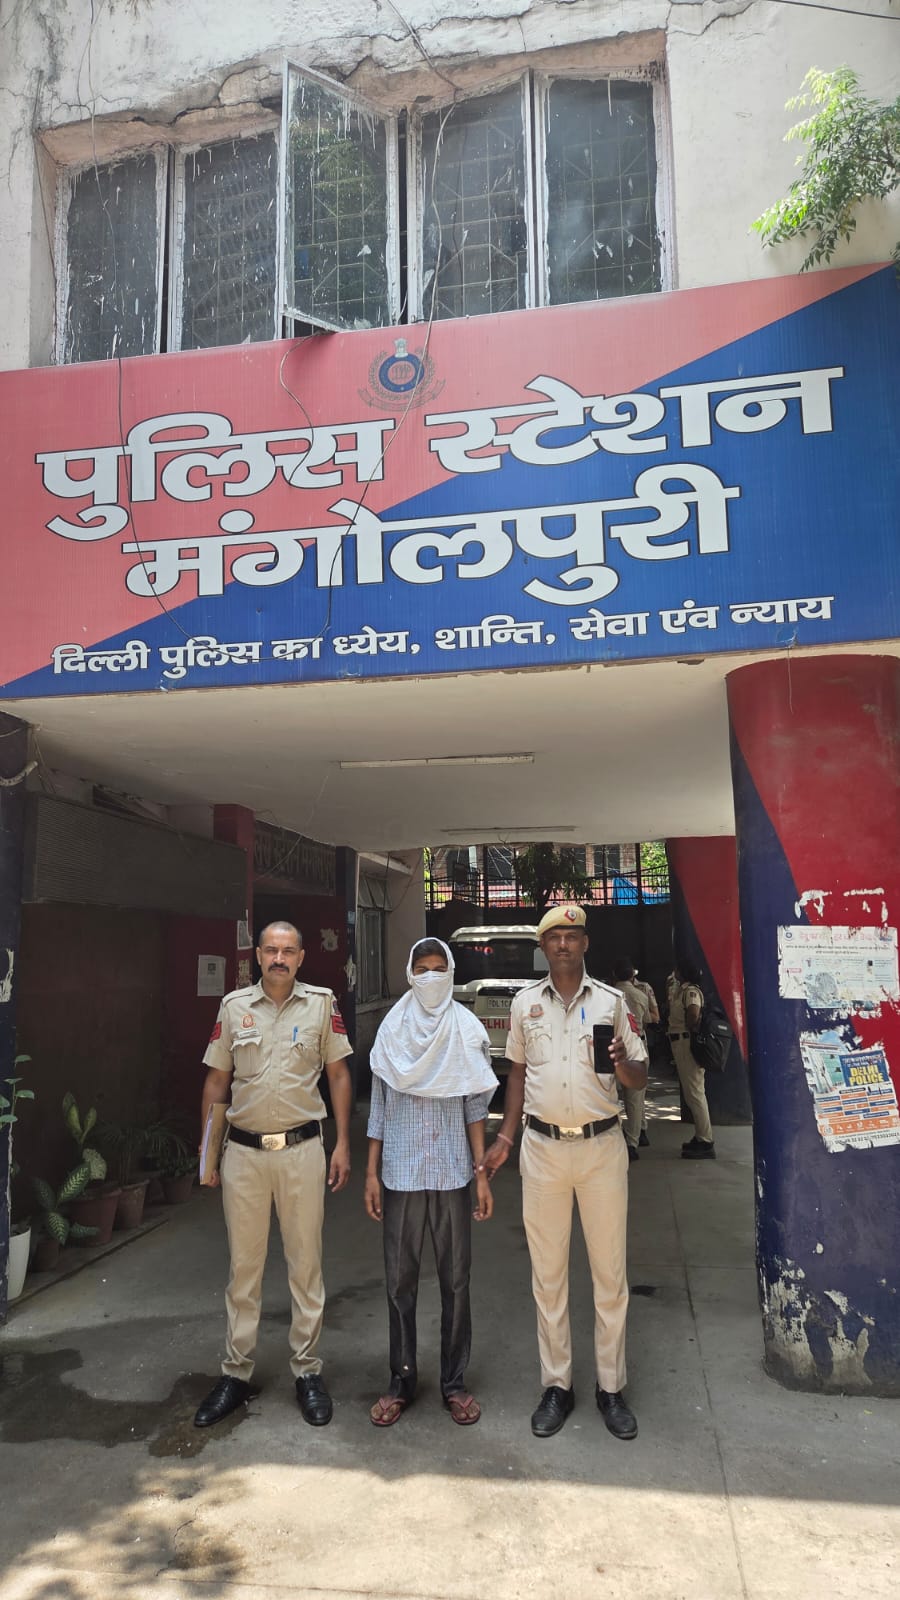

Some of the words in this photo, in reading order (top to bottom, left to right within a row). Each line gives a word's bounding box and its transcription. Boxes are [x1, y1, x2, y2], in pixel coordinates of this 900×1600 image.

[35, 411, 396, 542] पुलिस
[424, 367, 845, 474] स्टेशन
[122, 463, 741, 607] मंगोलपुरी
[51, 639, 151, 675] दिल्ली
[159, 635, 263, 680] पुलिस
[271, 636, 323, 660] का
[332, 624, 421, 656] ध्येय,
[434, 614, 556, 650] शान्ति,
[569, 607, 650, 641] सेवा
[729, 596, 834, 624] न्याय
[480, 1018, 505, 1029] ELHI
[849, 1073, 884, 1086] POLICE
[850, 1064, 879, 1077] DELHI
